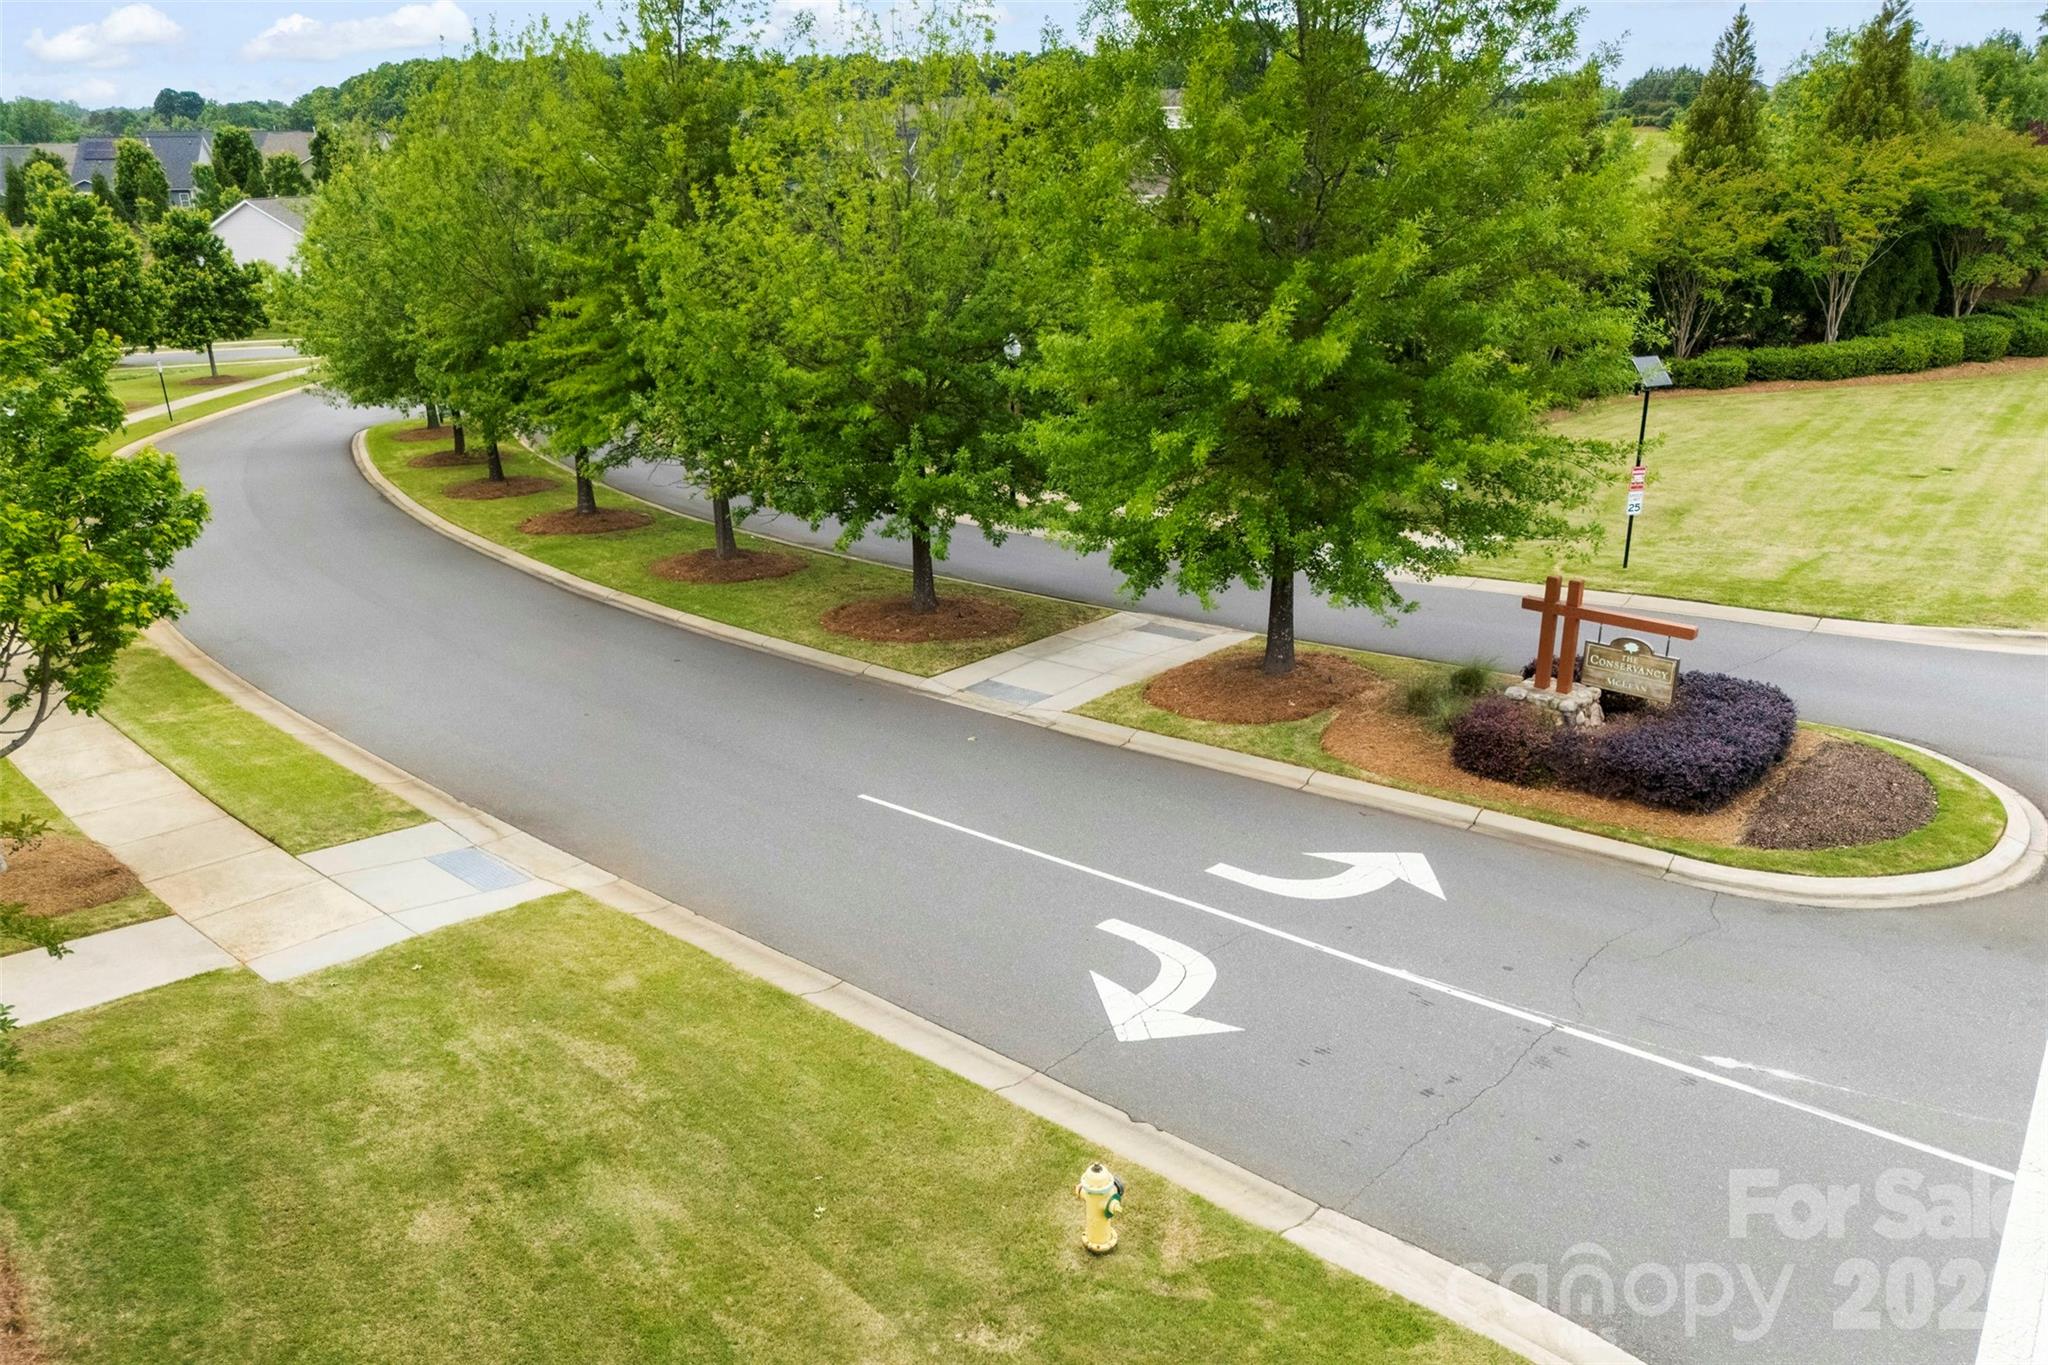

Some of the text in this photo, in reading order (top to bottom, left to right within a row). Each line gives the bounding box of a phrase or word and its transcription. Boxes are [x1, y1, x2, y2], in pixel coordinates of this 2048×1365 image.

[1628, 503, 1640, 512] 25
[1622, 655, 1638, 665] THE
[1590, 654, 1669, 680] CONSERVANCY
